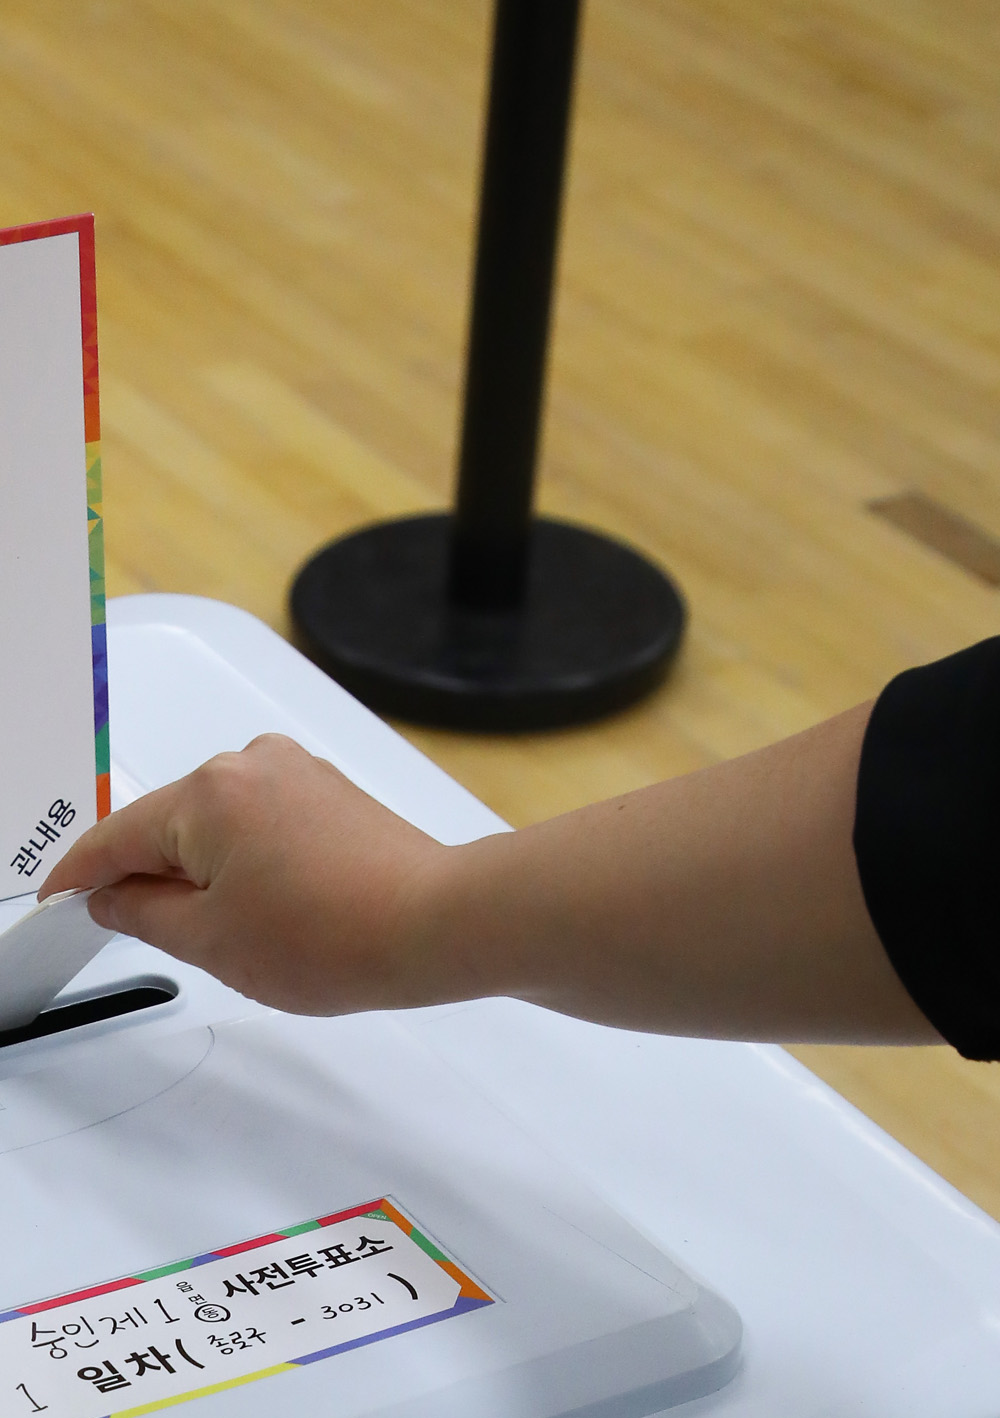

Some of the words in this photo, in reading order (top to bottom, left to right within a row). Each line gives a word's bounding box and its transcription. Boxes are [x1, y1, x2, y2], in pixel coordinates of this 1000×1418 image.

[10, 799, 76, 877] 관내용
[222, 1235, 394, 1299] 사전투표소
[16, 1382, 49, 1413] 1
[206, 1327, 268, 1355] 종로구
[320, 1292, 386, 1321] 3031
